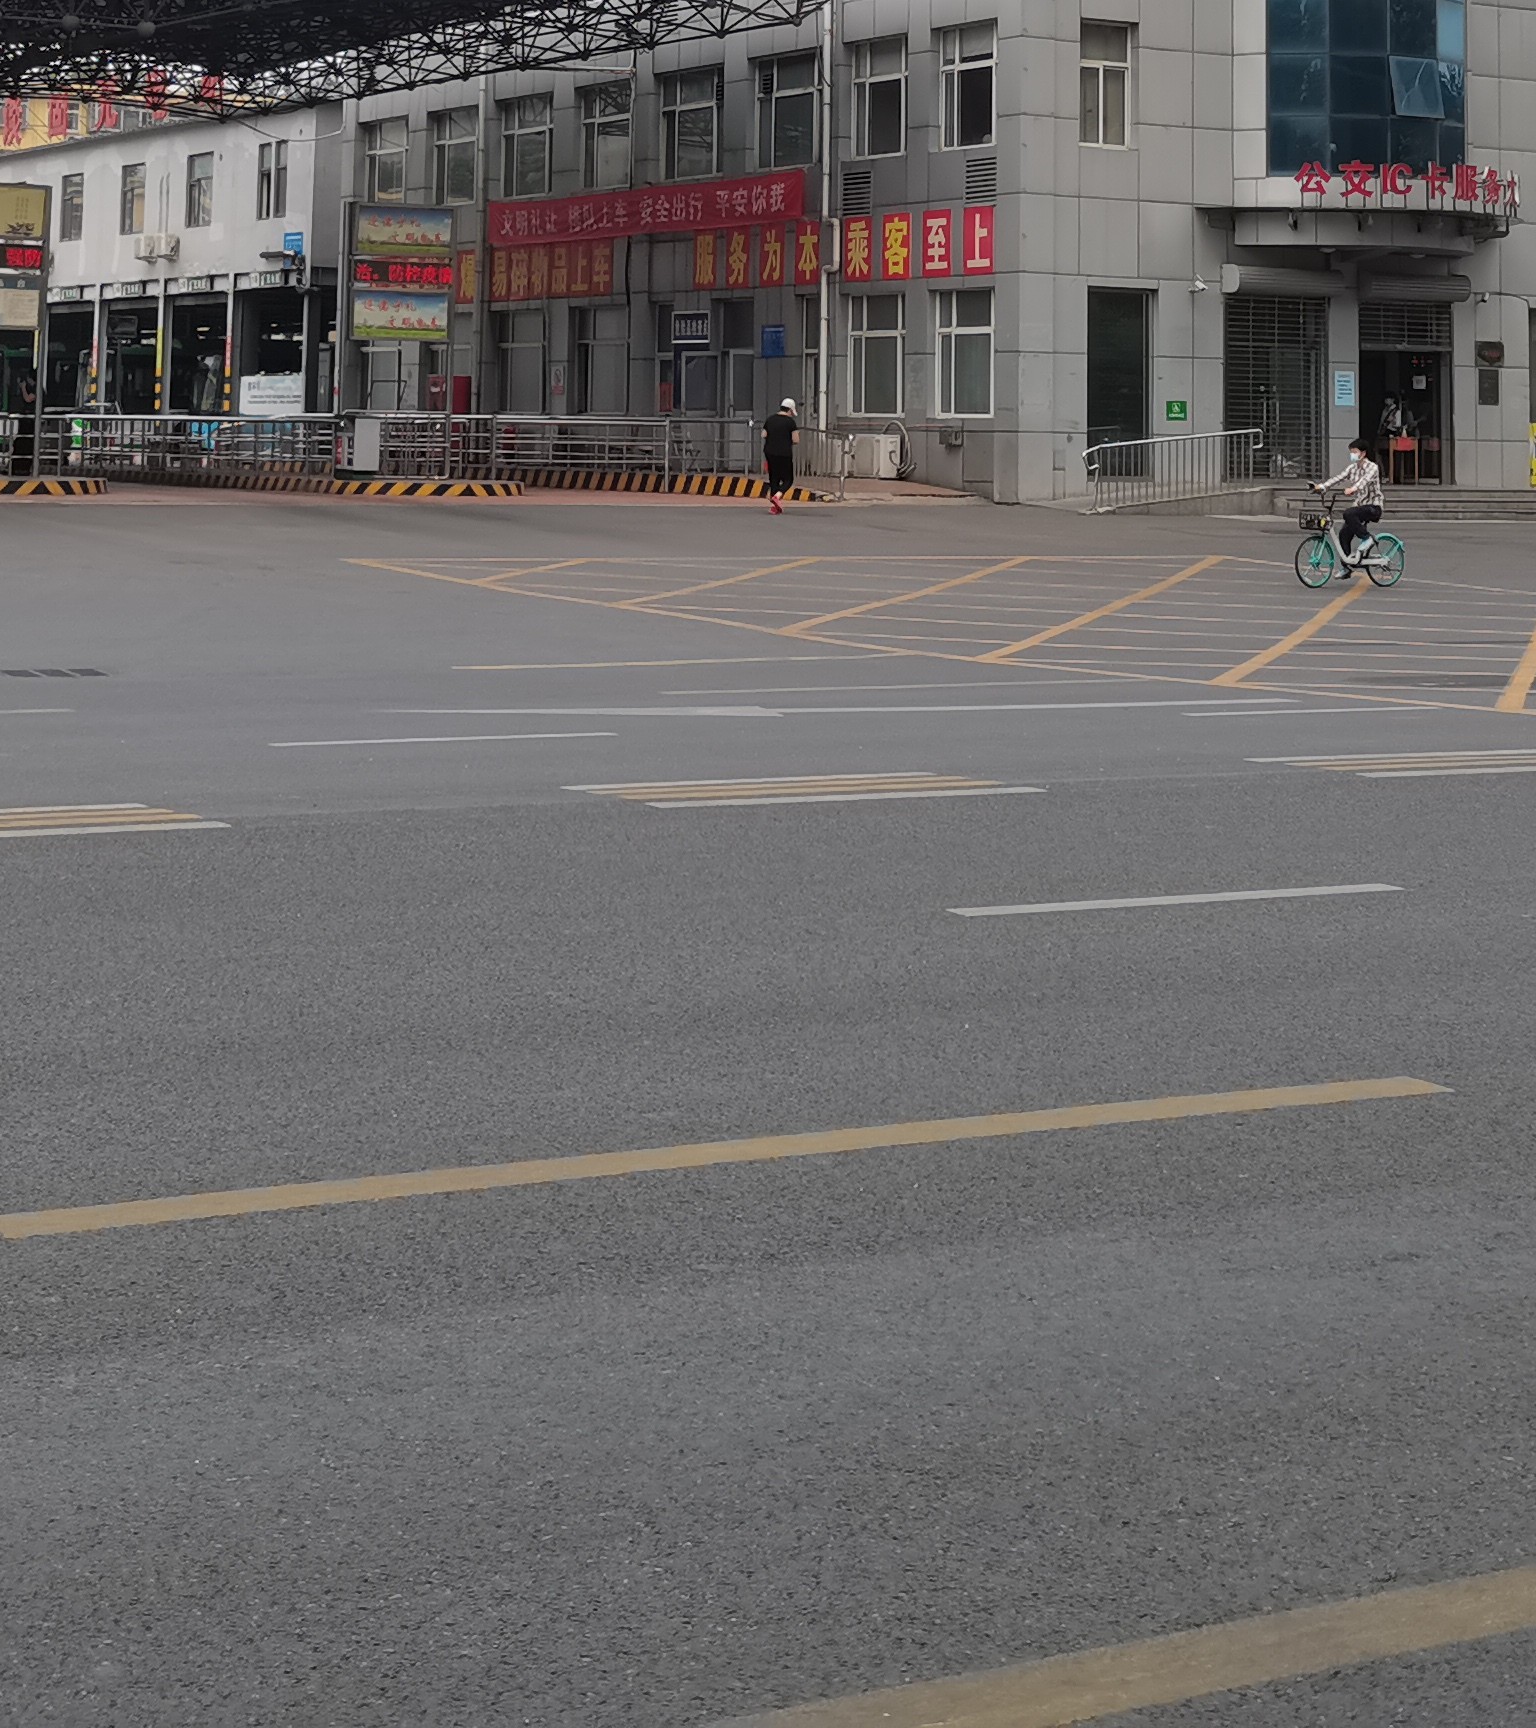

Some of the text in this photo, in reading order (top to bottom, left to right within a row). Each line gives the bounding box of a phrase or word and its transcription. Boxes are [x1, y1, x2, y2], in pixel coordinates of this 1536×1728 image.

[500, 207, 558, 236] 文明礼让
[639, 192, 706, 225] 安全出行
[716, 182, 785, 218] 平安你我
[695, 213, 990, 285] 服务为本 乘客至上
